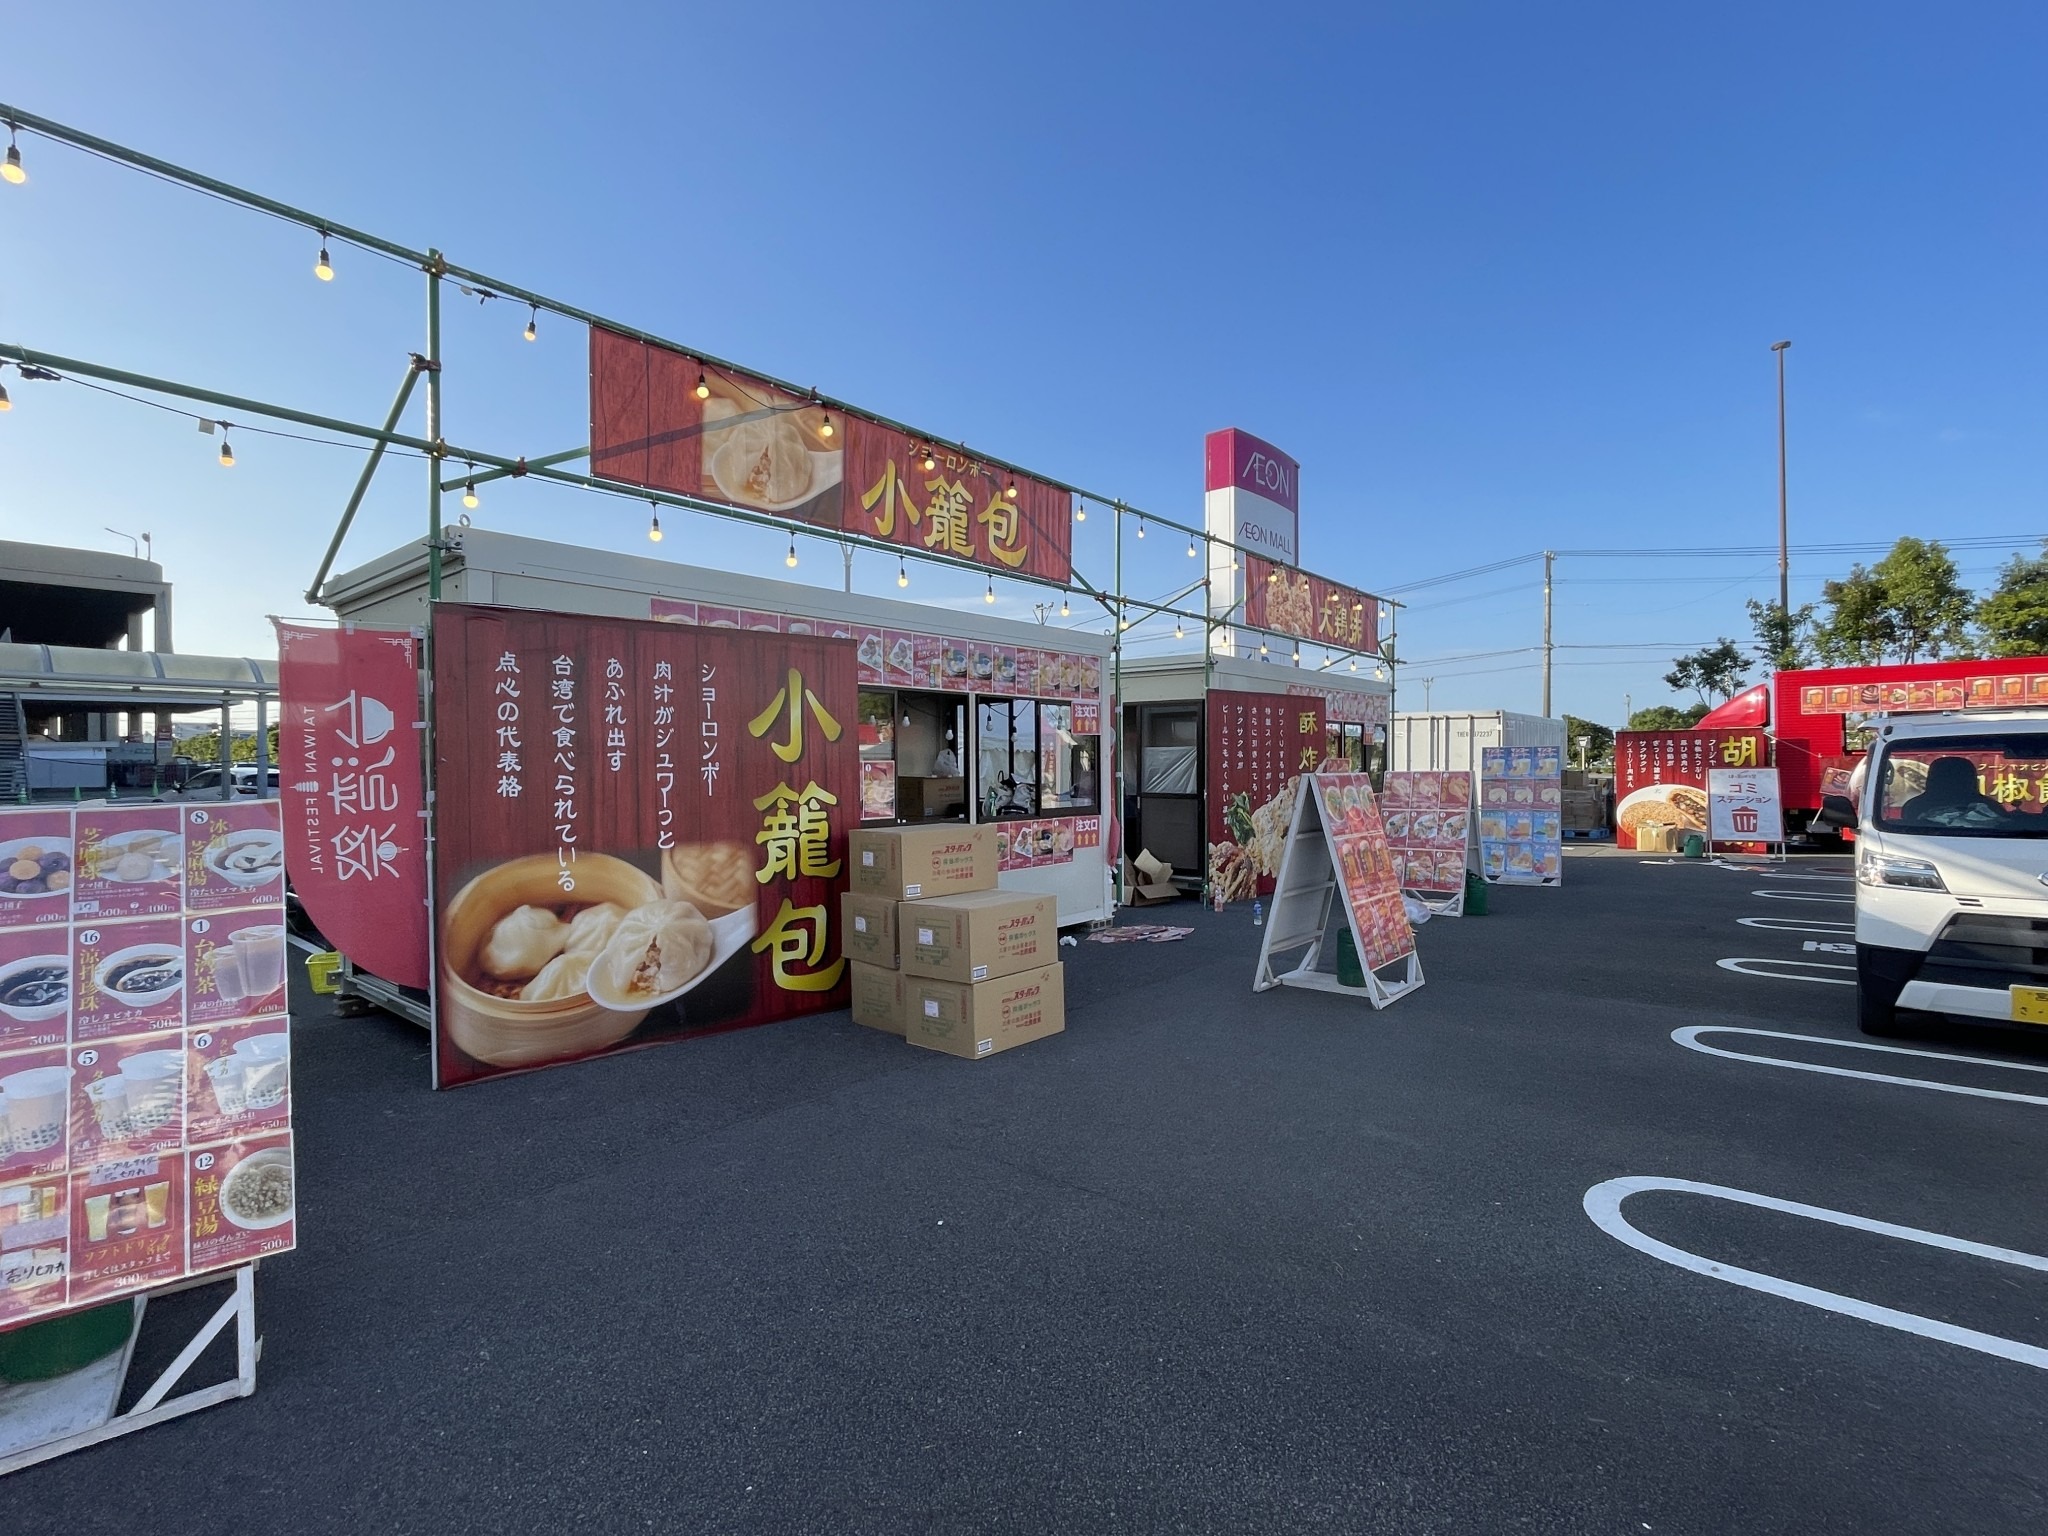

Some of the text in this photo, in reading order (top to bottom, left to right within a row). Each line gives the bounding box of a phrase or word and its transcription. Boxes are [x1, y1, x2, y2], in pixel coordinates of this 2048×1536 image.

[861, 458, 1028, 568] 小籠包
[1269, 530, 1293, 556] MALL
[1318, 603, 1363, 645] 大鶏排
[605, 657, 627, 773] あふれ出す
[1074, 704, 1098, 718] 注文口
[494, 650, 523, 799] 点心の代表格
[701, 663, 720, 797] ショーロンポー
[653, 660, 676, 850] 肉汁がジュワーっと
[1719, 735, 1758, 767] 胡
[551, 654, 580, 893] 台湾で食べられている
[1717, 795, 1772, 804] ステーション
[1729, 782, 1758, 794] ゴミ
[747, 667, 845, 993] 小籠包
[1075, 819, 1098, 832] 注文口
[251, 894, 280, 905] 600円
[35, 912, 67, 923] 600円
[82, 931, 98, 943] 16
[194, 939, 216, 994] 台湾茶
[79, 1008, 143, 1025] 冷しタピオカ
[29, 1033, 65, 1046] 500円
[198, 1155, 213, 1168] 12
[194, 1174, 219, 1238] 緑豆湯
[85, 1233, 172, 1263] ソフトドリンク
[260, 1237, 290, 1253] 500円
[113, 1272, 149, 1288] 300円
